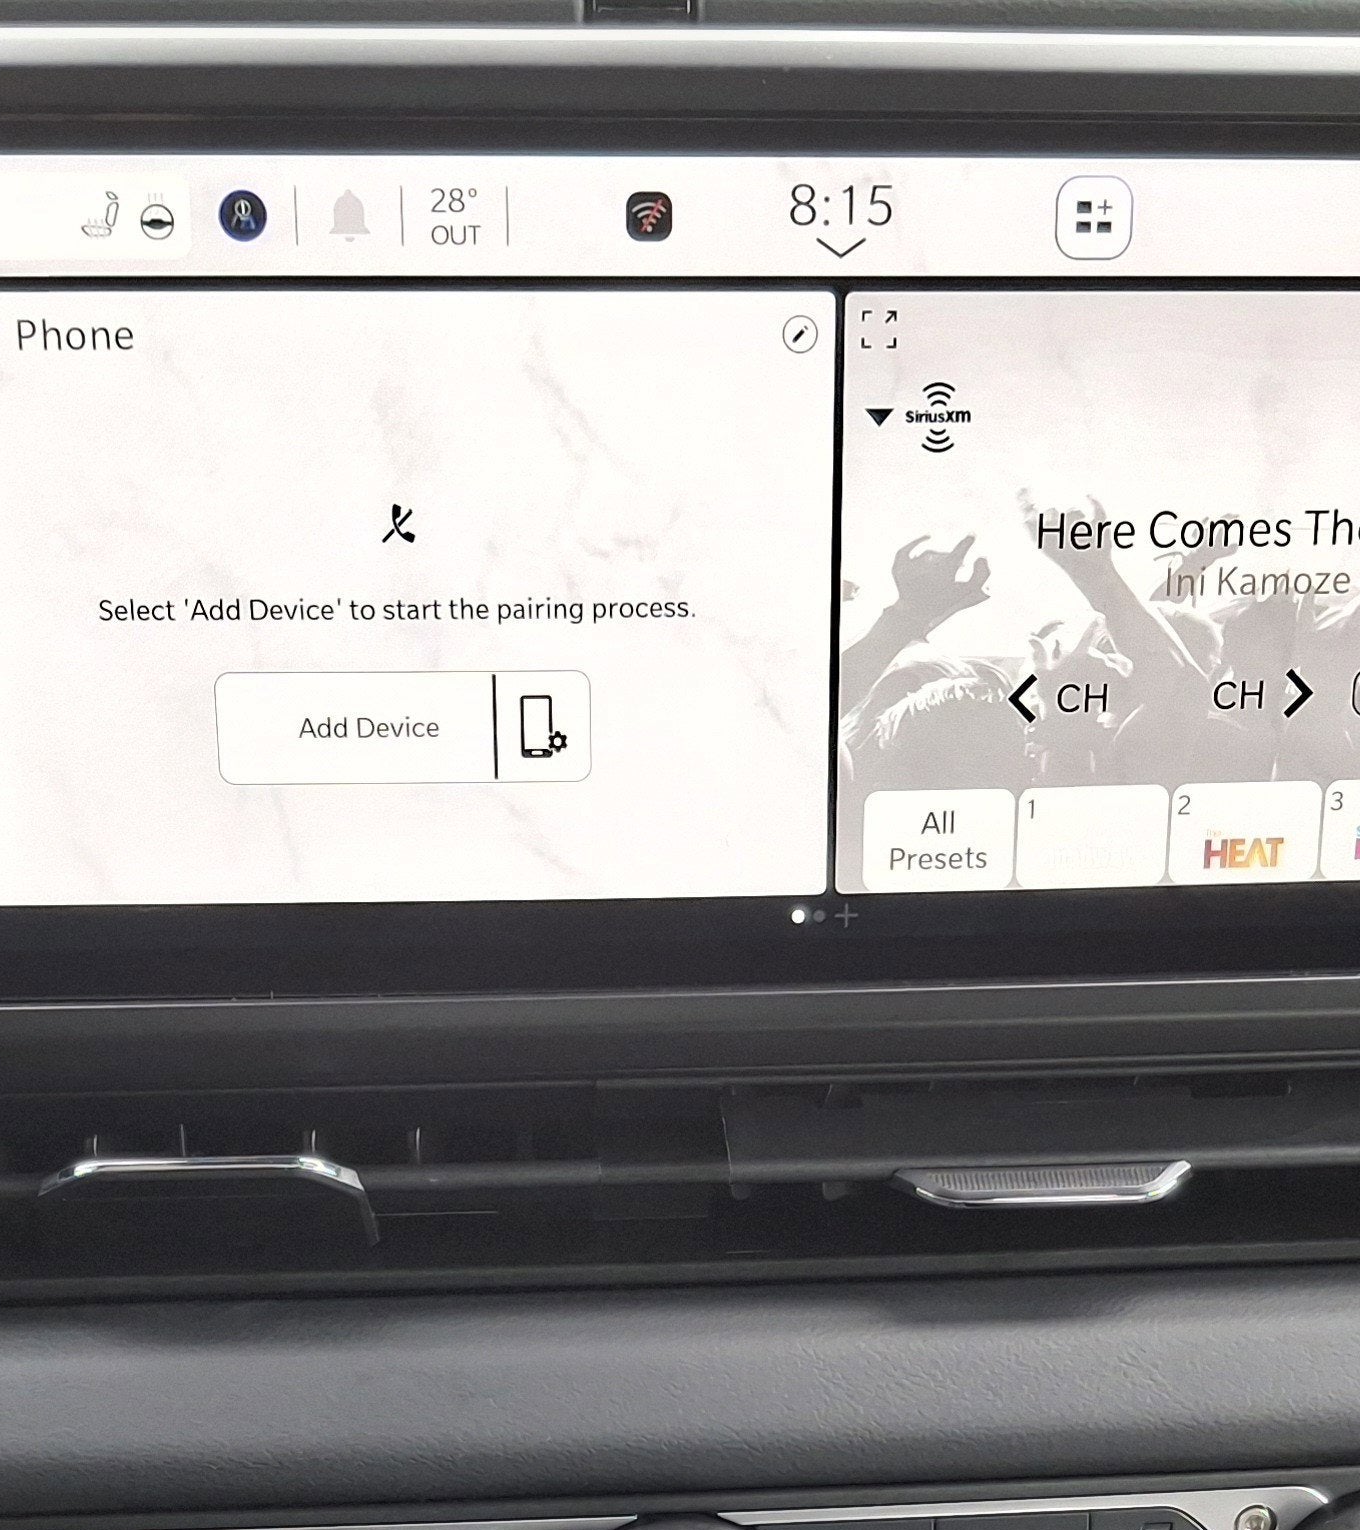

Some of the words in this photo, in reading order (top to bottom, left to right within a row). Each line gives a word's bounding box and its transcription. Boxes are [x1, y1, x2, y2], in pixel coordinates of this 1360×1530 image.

[430, 187, 478, 214] 28°
[790, 183, 894, 227] 8:15
[430, 225, 482, 247] OUT
[16, 318, 135, 352] Phone
[1037, 512, 1136, 551] Here
[1149, 510, 1293, 550] Comes
[1165, 566, 1207, 598] Ini
[1218, 565, 1352, 597] Kamoze
[98, 598, 176, 622] Select
[184, 599, 241, 622] 'Add
[250, 599, 342, 622] Device'
[350, 602, 376, 622] to
[383, 601, 442, 621] start
[448, 598, 490, 621] the
[497, 597, 584, 624] pairing
[592, 600, 696, 624] process.
[1057, 683, 1110, 713] CH
[1212, 680, 1265, 711] CH
[299, 716, 348, 739] Add
[356, 716, 440, 739] Device
[1026, 799, 1036, 820] 1
[1177, 795, 1191, 815] 2
[1330, 791, 1344, 811] 3
[921, 811, 957, 836] All
[888, 844, 989, 871] Presets
[1203, 836, 1285, 869] HEAT
